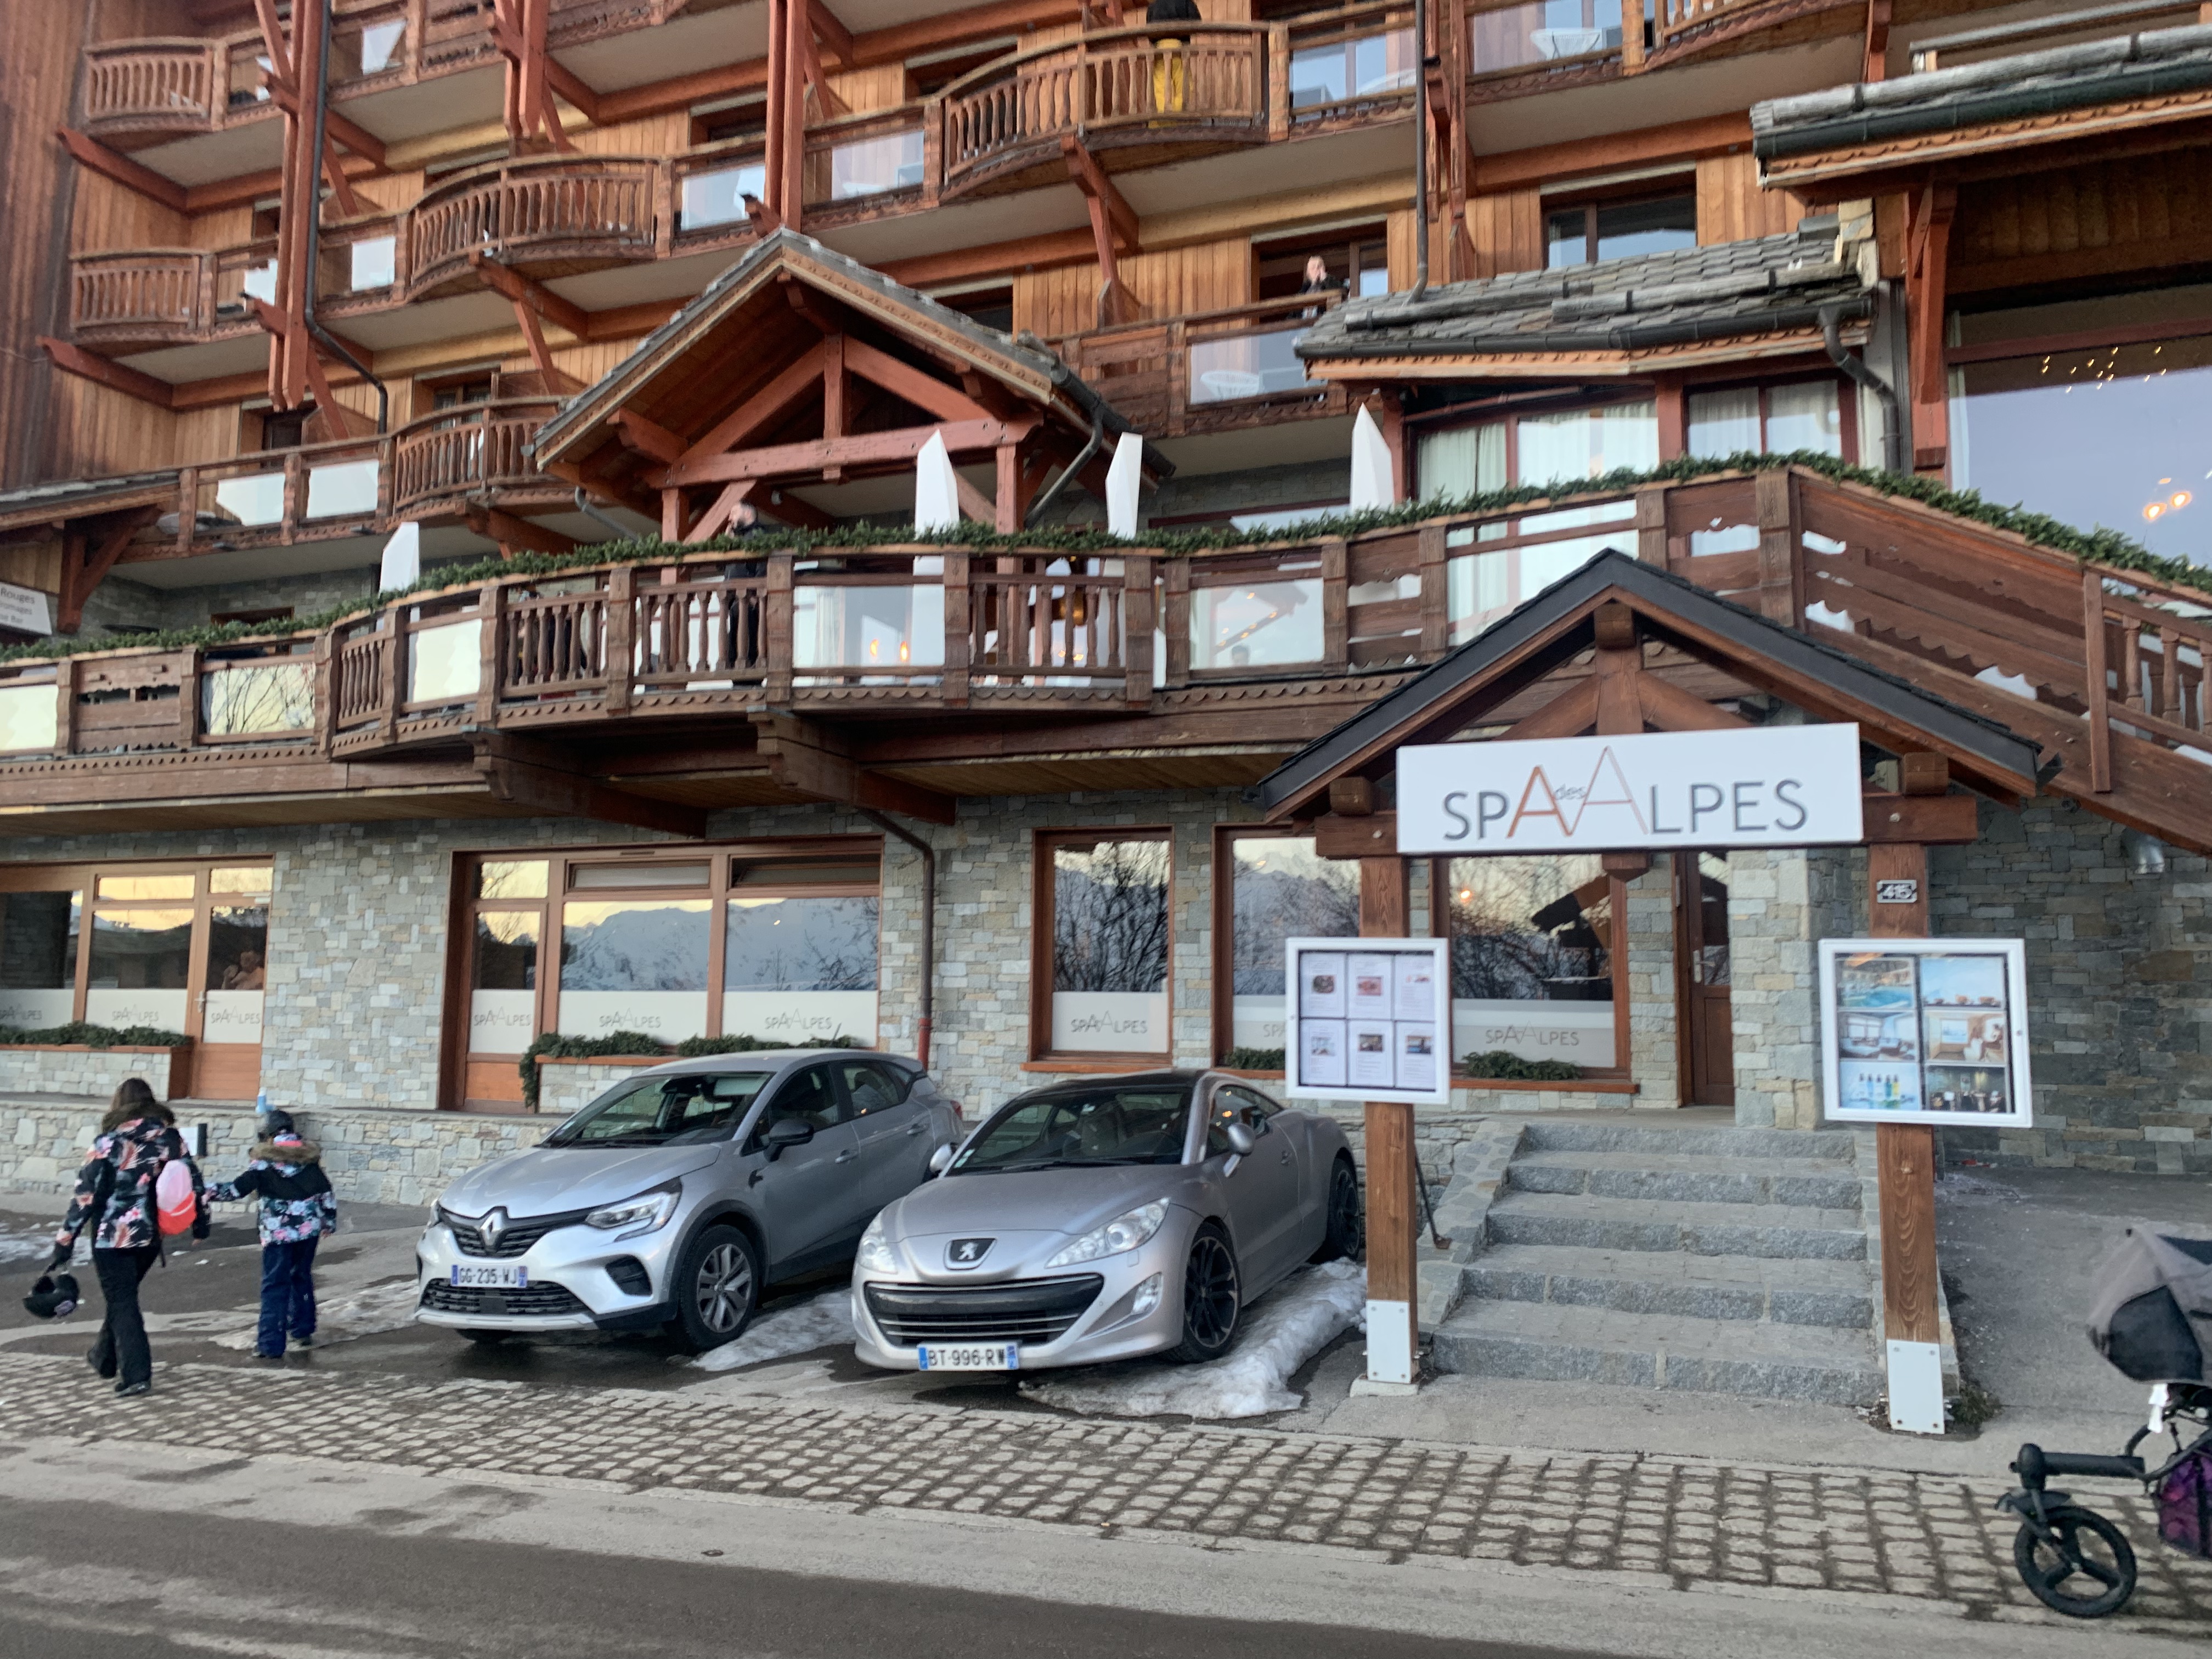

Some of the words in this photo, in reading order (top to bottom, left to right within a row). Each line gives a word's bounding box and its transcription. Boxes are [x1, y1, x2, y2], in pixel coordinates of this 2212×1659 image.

[1, 587, 35, 604] Rouges
[1442, 765, 1574, 840] SPA
[1565, 746, 1809, 837] ALPES
[459, 1267, 517, 1285] GG-235-WJ
[928, 1348, 1005, 1366] BT-996-RW
